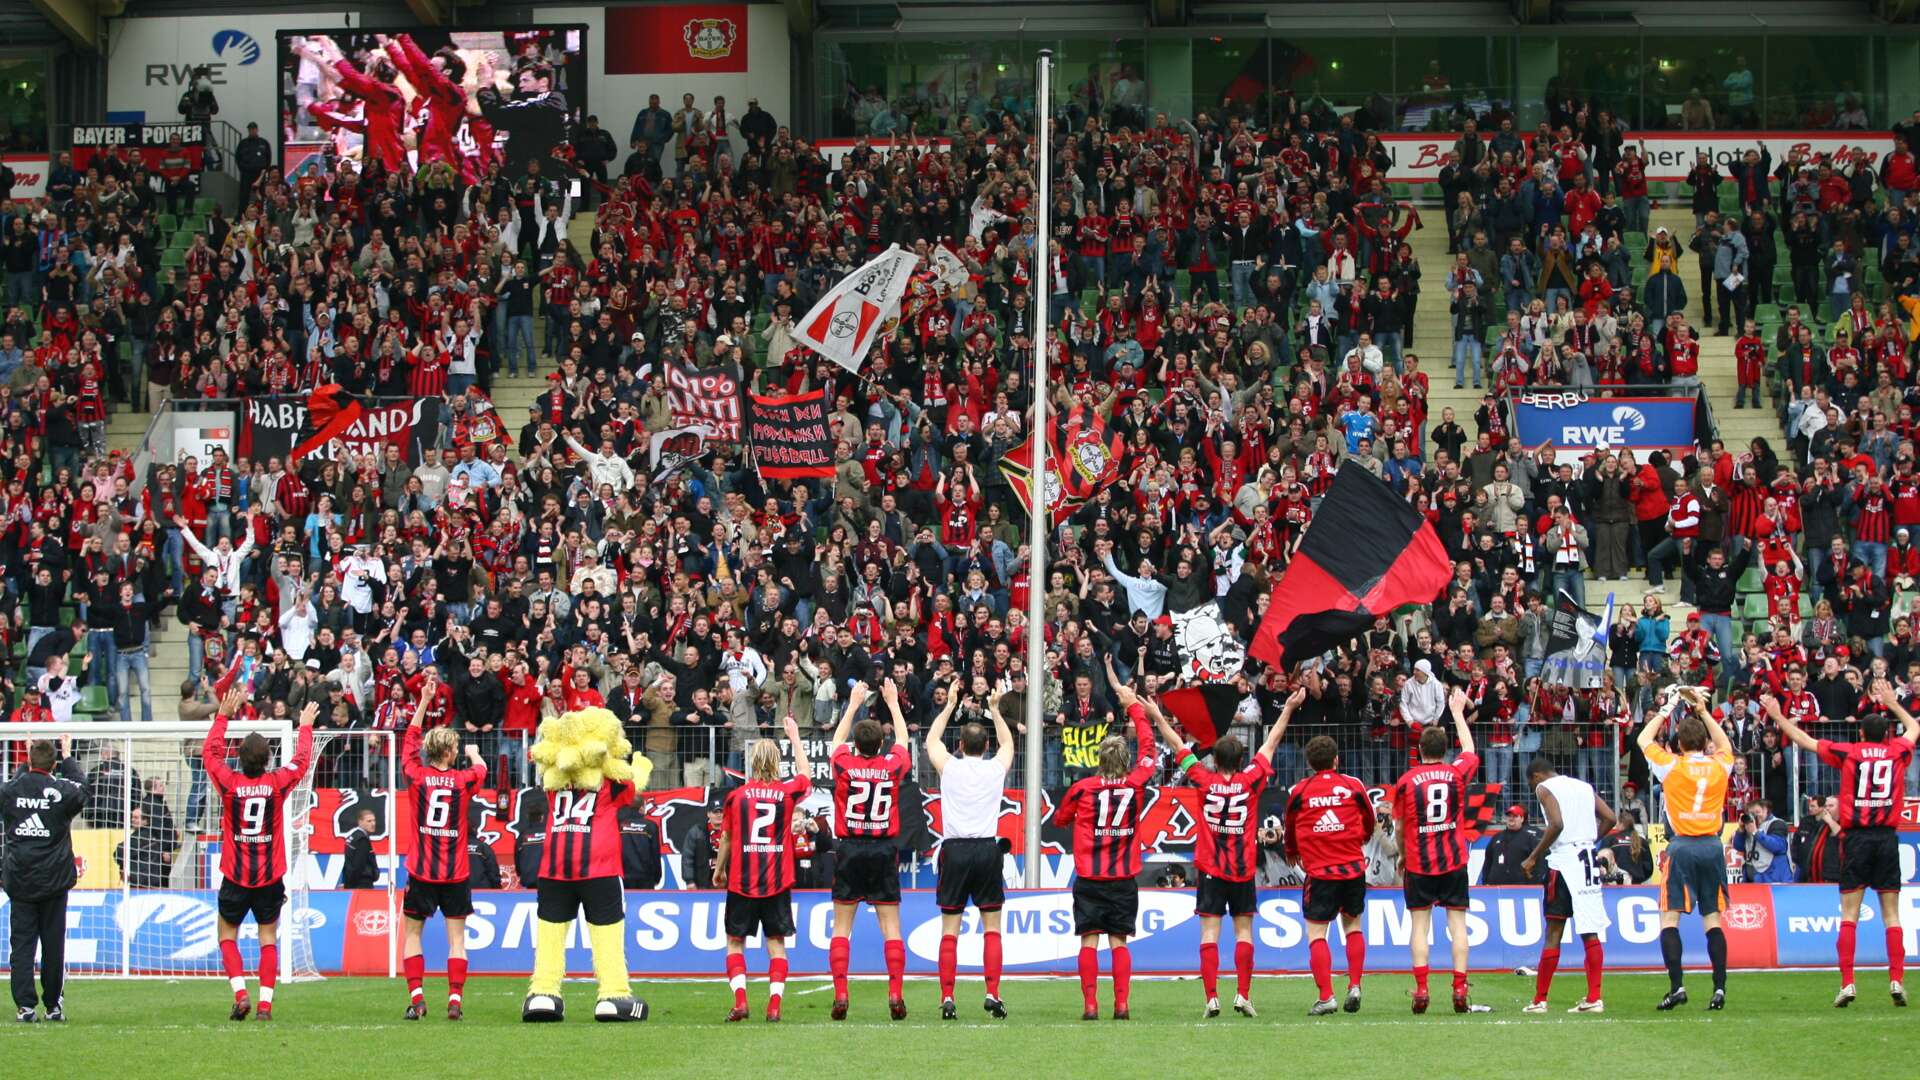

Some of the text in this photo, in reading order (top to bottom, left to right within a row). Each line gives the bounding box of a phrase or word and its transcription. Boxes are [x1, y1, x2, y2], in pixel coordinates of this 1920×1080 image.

[145, 63, 227, 86] RWE
[73, 127, 126, 144] BAYER
[142, 125, 202, 144] POWER
[1562, 426, 1625, 444] RWE
[425, 775, 455, 788] ROLFES
[745, 787, 785, 802] STENMAN
[1692, 777, 1708, 812] 1
[1857, 760, 1893, 799] 19
[16, 797, 51, 809] RWE
[241, 797, 267, 835] 9
[426, 788, 453, 828] 6
[553, 790, 598, 827] 04
[845, 780, 895, 822] 26
[1096, 788, 1135, 827] 17
[1202, 792, 1250, 827] 25
[1309, 795, 1343, 808] RWE
[1426, 782, 1450, 823] 8
[15, 828, 51, 837] adidas
[750, 802, 777, 844] 2
[1313, 823, 1345, 833] adidas
